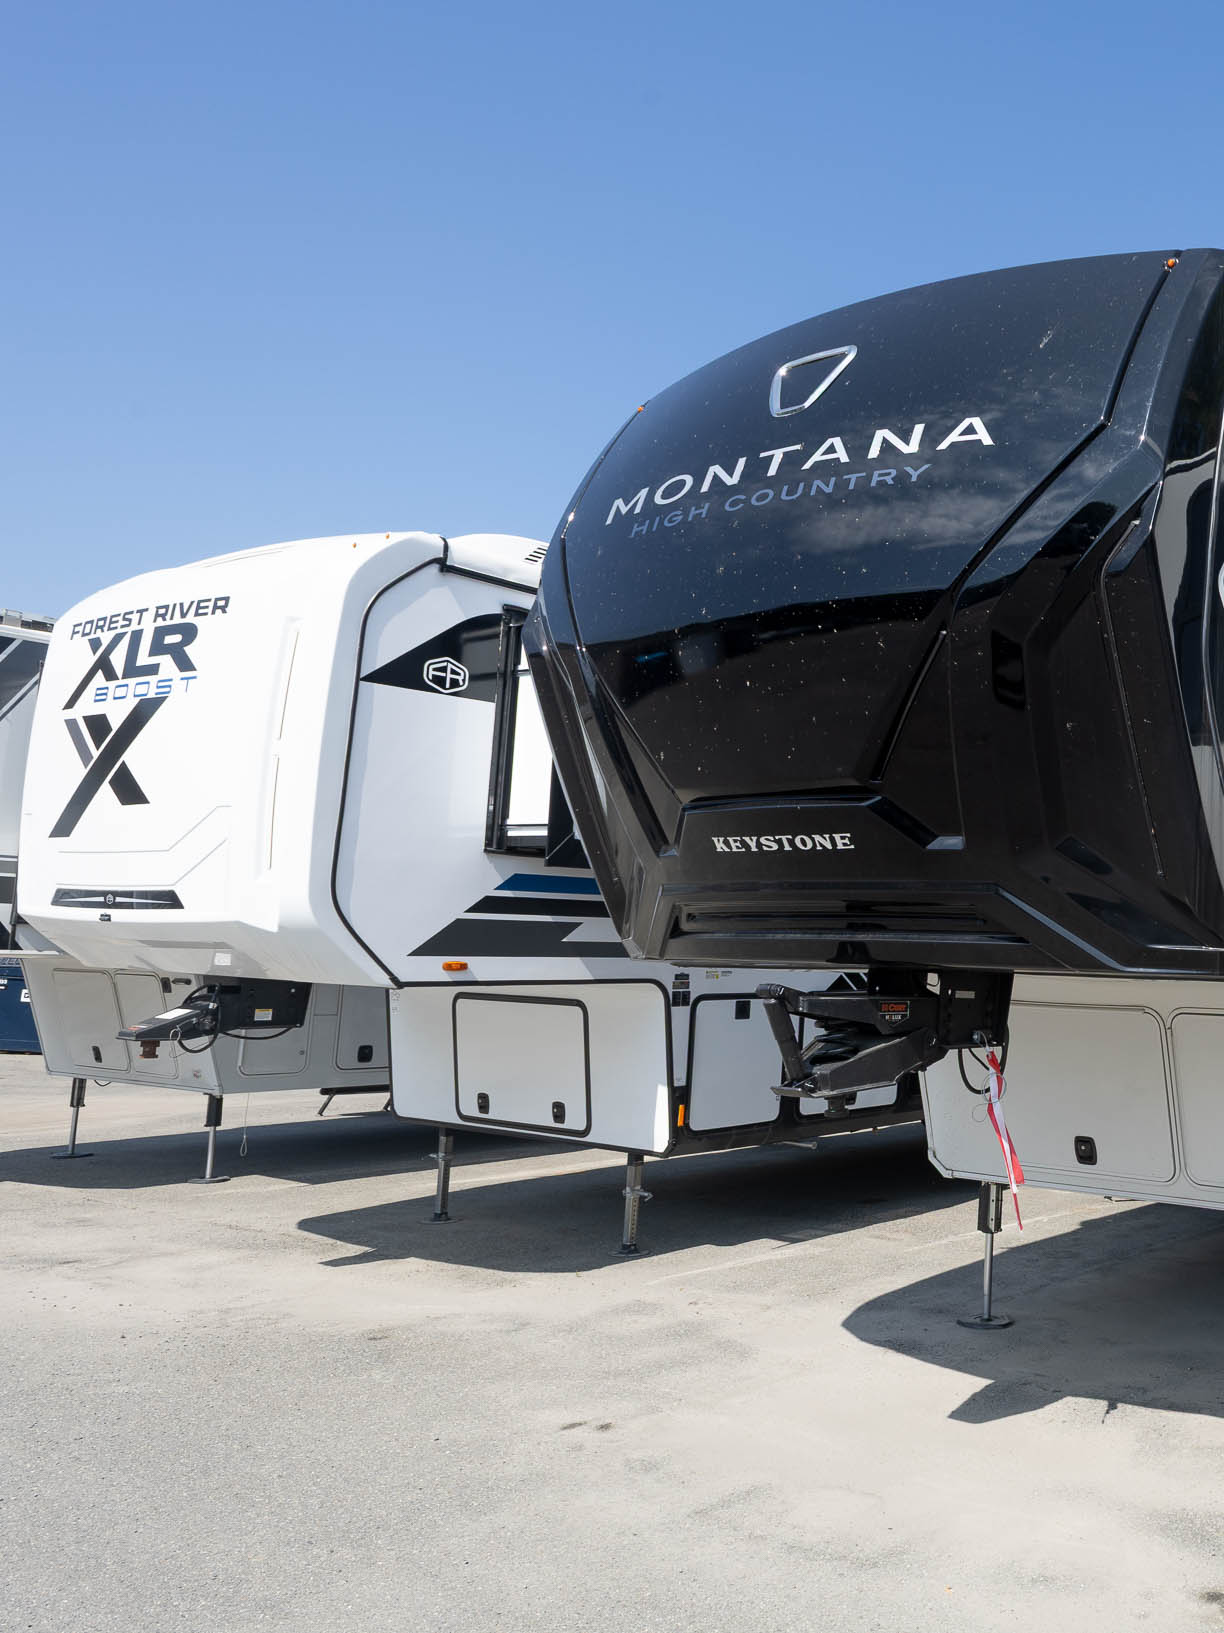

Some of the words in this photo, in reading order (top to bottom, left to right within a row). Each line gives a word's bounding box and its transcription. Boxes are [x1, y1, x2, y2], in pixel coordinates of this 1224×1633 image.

[605, 416, 995, 526] MONTANA
[629, 502, 711, 539] HIGH
[724, 463, 934, 513] COUNTRY
[70, 608, 150, 641] FOREST
[153, 596, 231, 623] RIVER
[62, 622, 199, 711] XLR
[93, 675, 198, 703] BOOST
[711, 832, 855, 852] KEYSTONE
